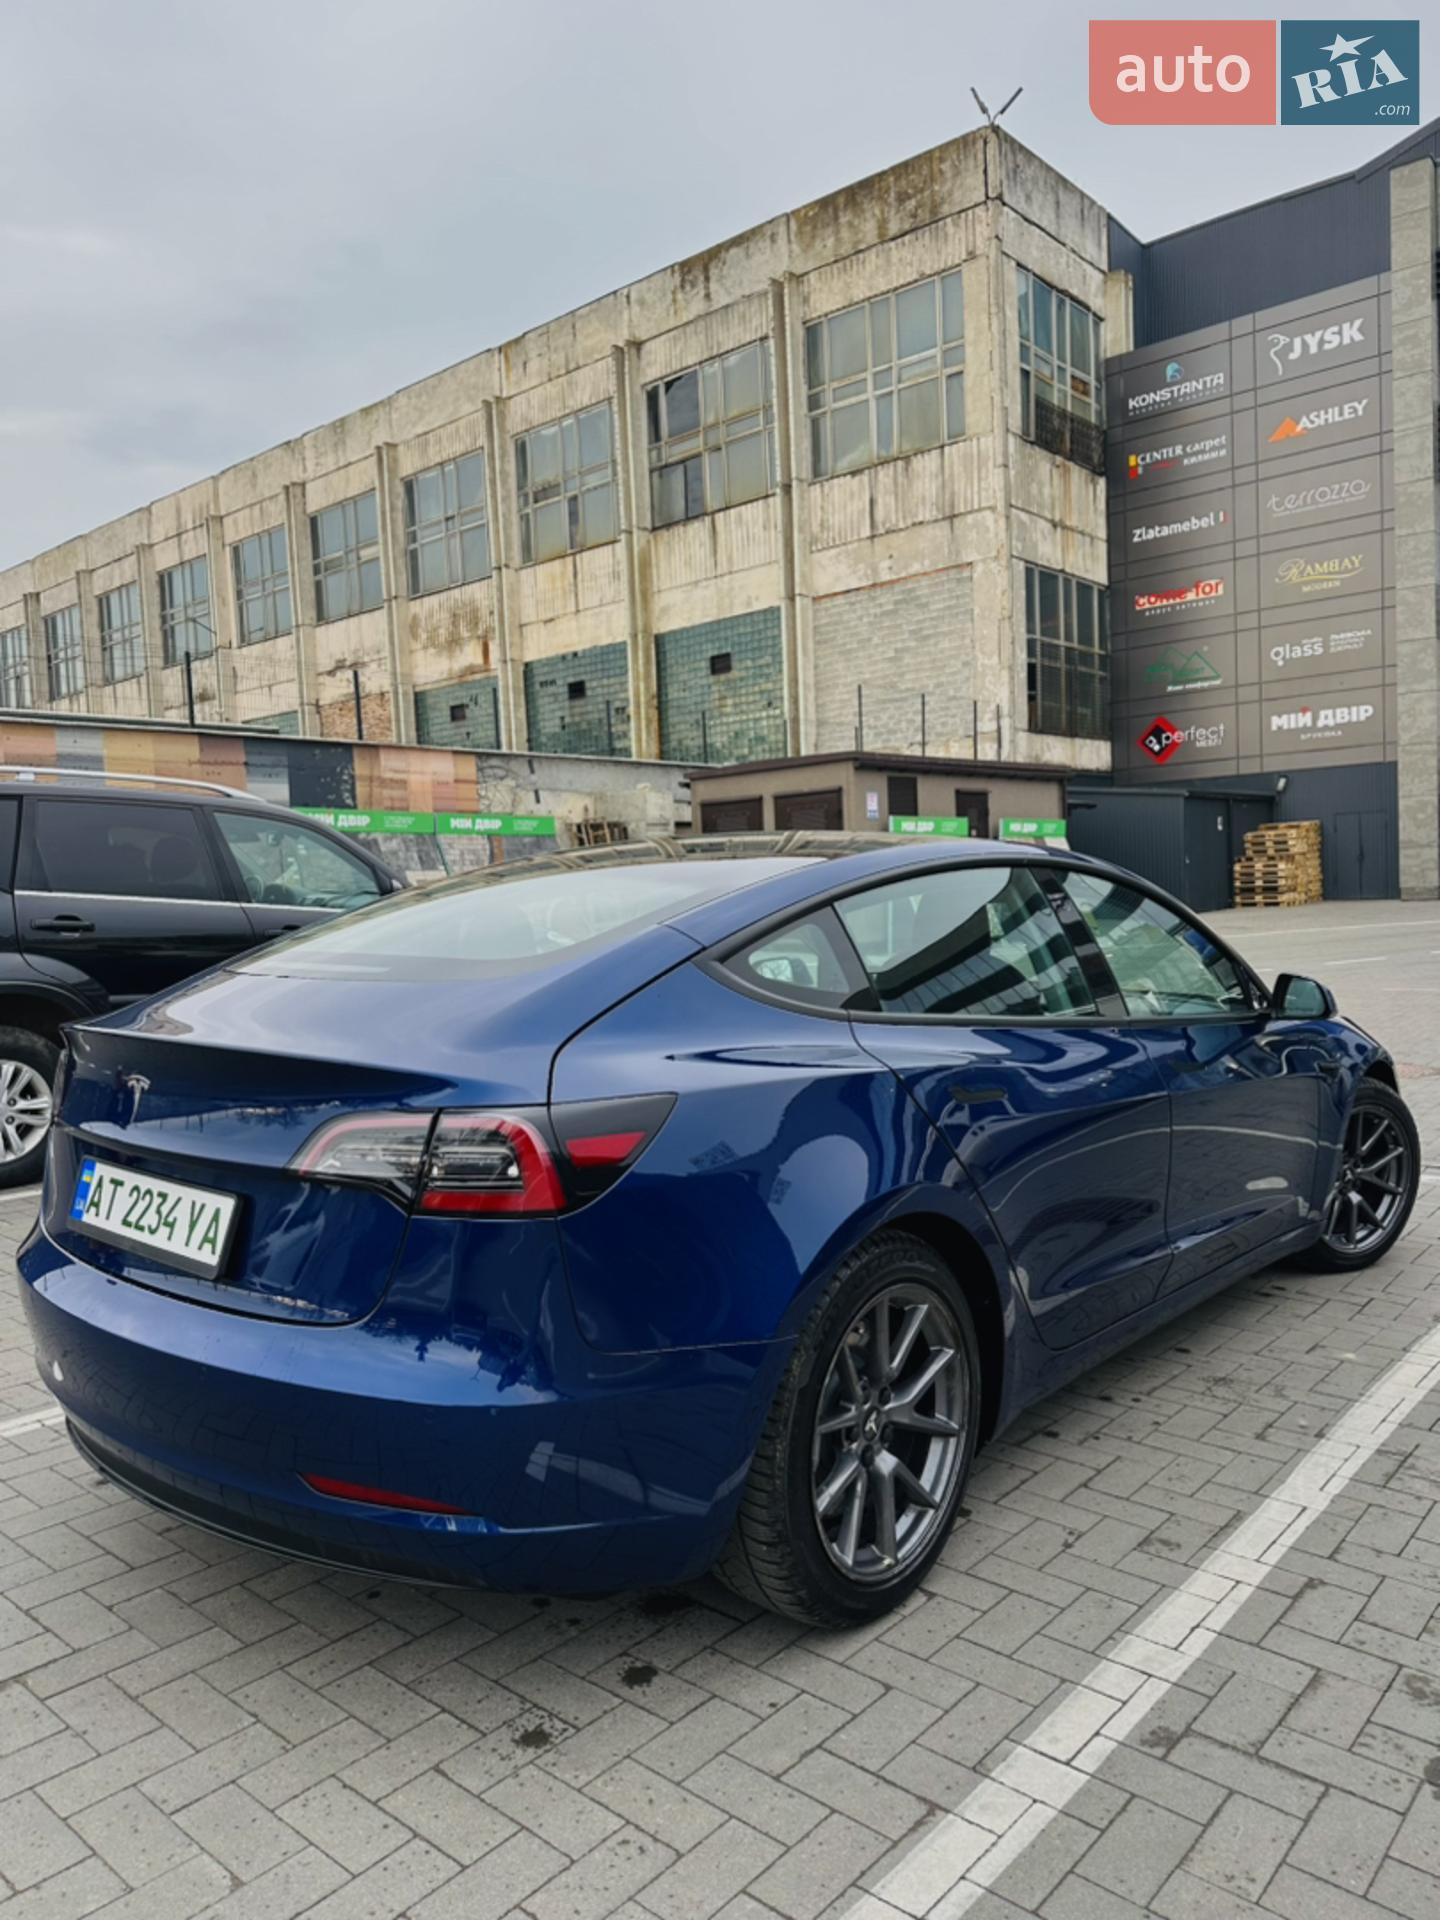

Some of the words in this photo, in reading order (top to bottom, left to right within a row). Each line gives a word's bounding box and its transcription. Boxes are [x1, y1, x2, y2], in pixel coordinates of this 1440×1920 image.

[1288, 318, 1365, 360] JYSK
[1128, 372, 1224, 410] KONSTANTA
[1295, 399, 1369, 432] ASHLEY
[1137, 444, 1183, 465] CENTER
[1186, 434, 1227, 453] carpet
[1132, 511, 1215, 543] Zlatamebel
[1270, 643, 1324, 667] glass
[1271, 707, 1312, 731] МІЙ
[1317, 704, 1374, 728] ДВІР
[1162, 723, 1224, 748] perfect
[86, 1175, 125, 1220] AT
[121, 1184, 183, 1242] 2234
[185, 1200, 221, 1256] YA
